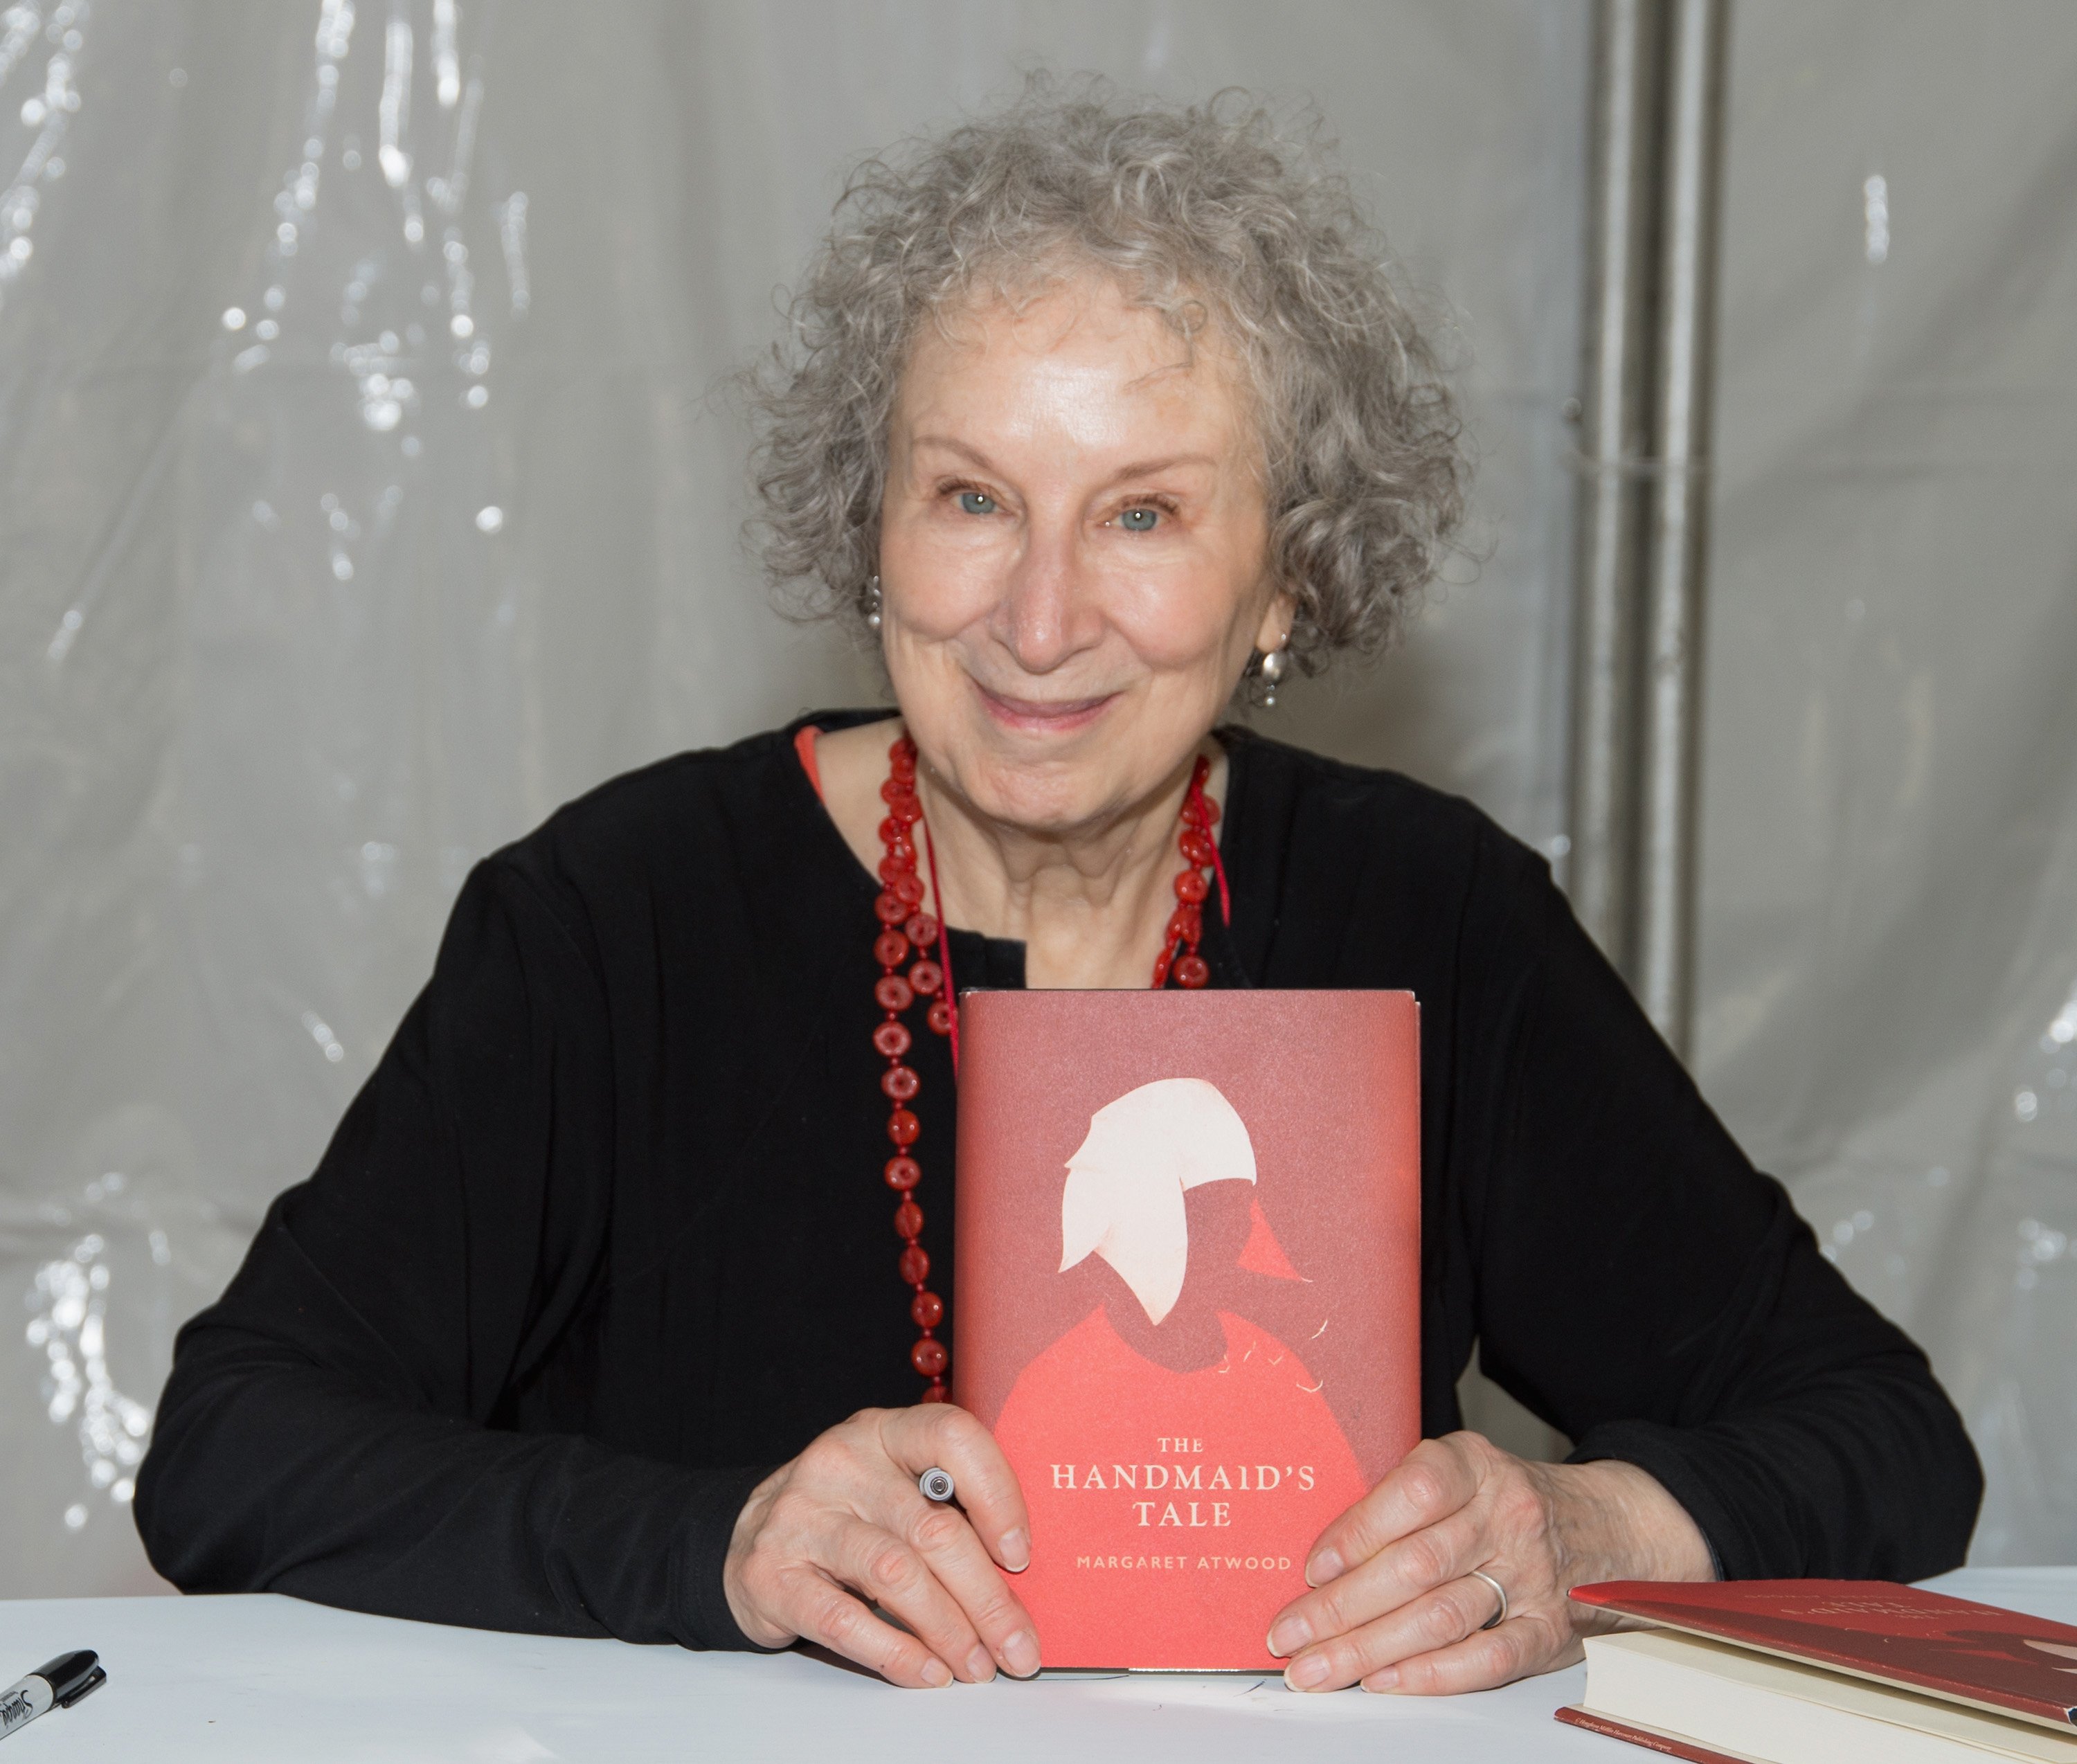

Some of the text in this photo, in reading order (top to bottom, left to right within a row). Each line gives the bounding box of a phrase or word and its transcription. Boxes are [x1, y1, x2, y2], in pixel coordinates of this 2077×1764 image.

[1157, 1437, 1204, 1452] THE
[1050, 1464, 1315, 1491] HANDMAID'S
[1132, 1502, 1231, 1527] TALE
[1077, 1556, 1291, 1570] MARGARET ATWOOD
